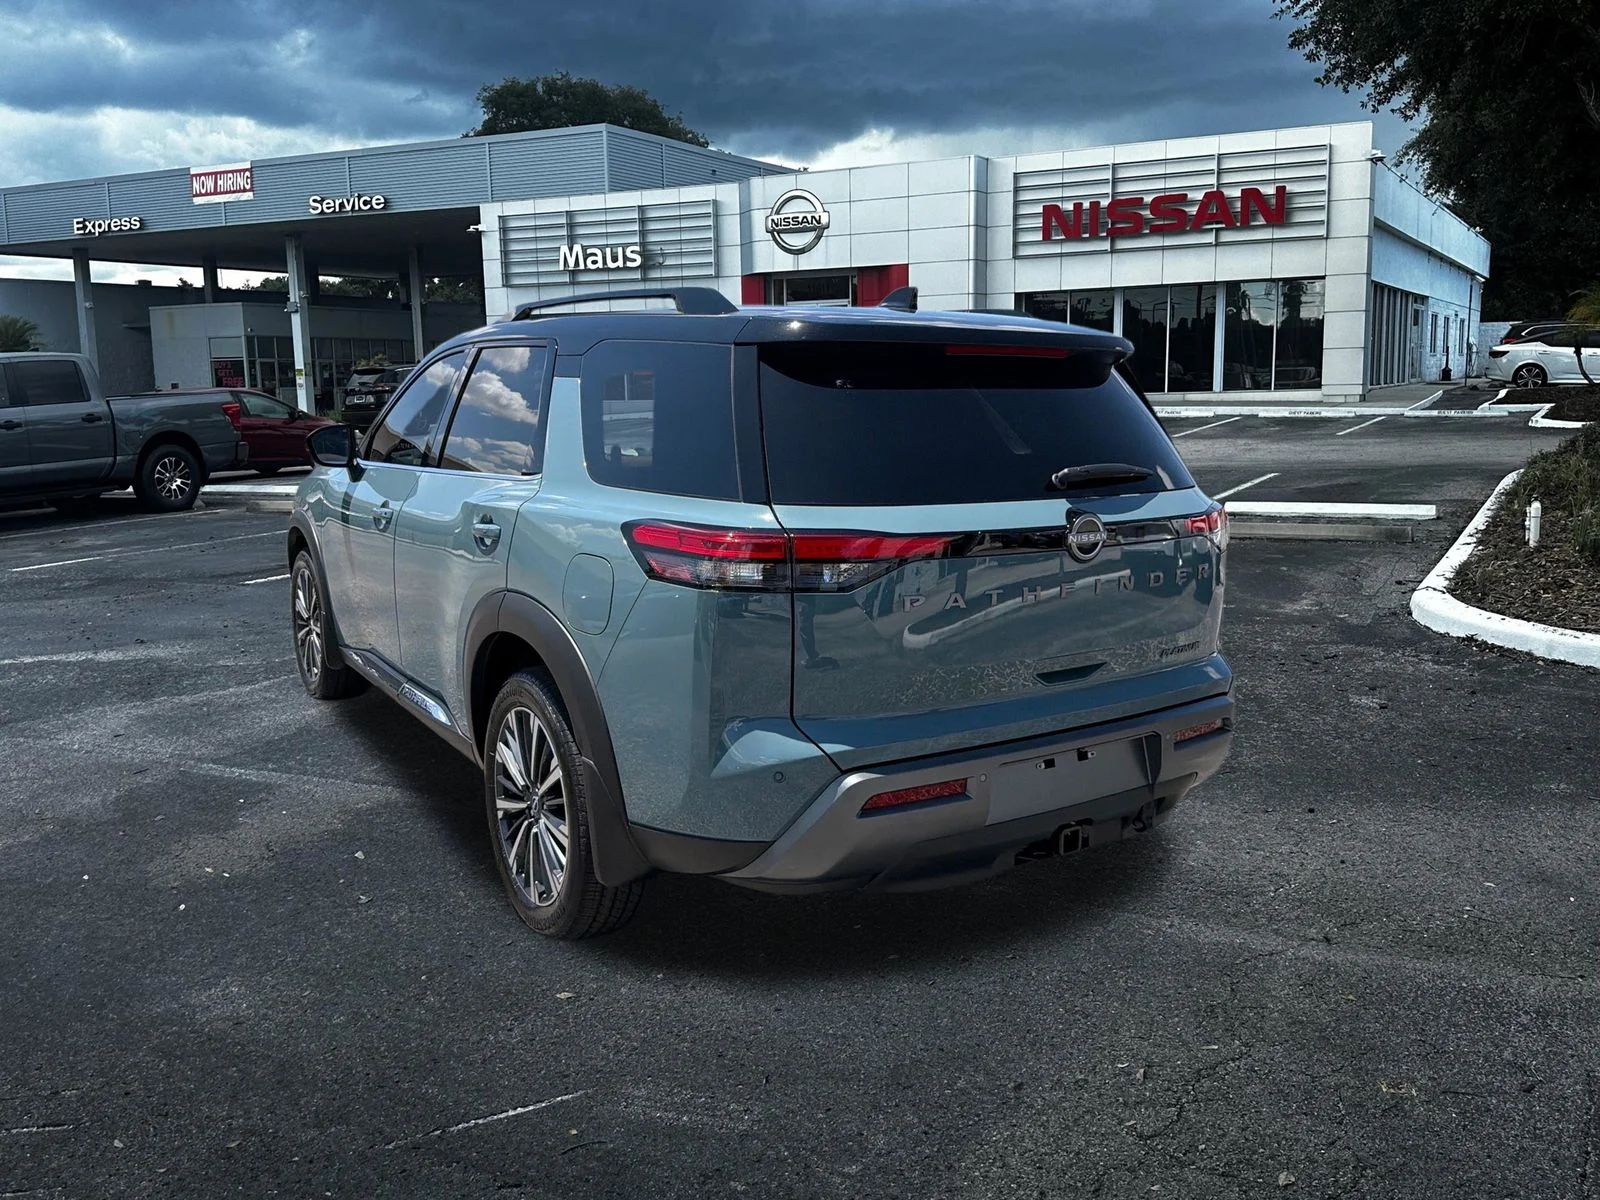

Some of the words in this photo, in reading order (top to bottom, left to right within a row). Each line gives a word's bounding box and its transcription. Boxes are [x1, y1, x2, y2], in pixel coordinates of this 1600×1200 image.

[192, 175, 214, 195] NOW
[217, 171, 251, 192] HIRING
[309, 192, 386, 215] Service
[1042, 185, 1287, 241] NISSAN
[73, 216, 141, 236] Express
[770, 214, 822, 228] NISSAN
[559, 243, 642, 271] Maus
[1069, 532, 1107, 543] NISSAN
[903, 562, 1210, 613] PATHFINDER
